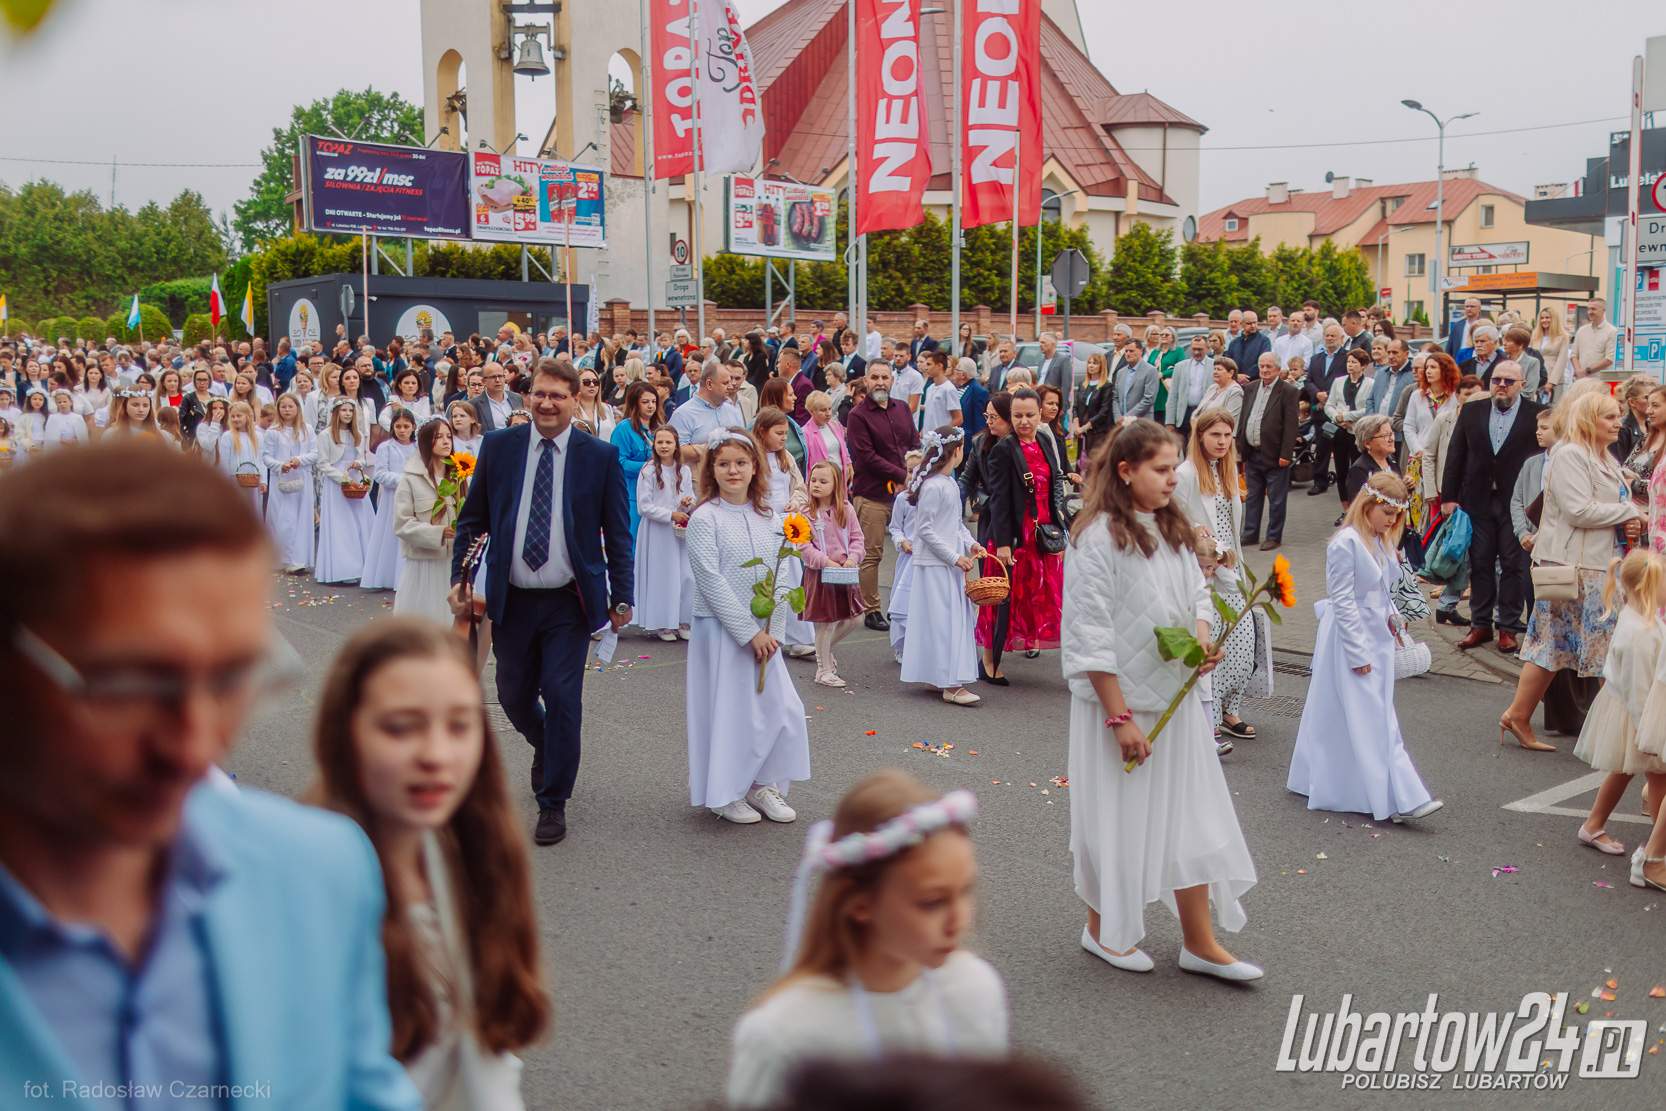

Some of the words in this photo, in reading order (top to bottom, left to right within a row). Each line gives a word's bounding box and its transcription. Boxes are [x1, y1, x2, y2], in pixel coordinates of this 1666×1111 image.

[663, 0, 703, 138] TOPA
[968, 0, 1020, 185] NEO
[316, 140, 353, 155] TOPAZ
[324, 167, 346, 180] za
[476, 165, 501, 176] TOPAZ
[513, 160, 543, 174] HITY
[395, 187, 424, 196] FITNESS
[337, 209, 362, 218] OTWARTE
[676, 246, 685, 258] 10
